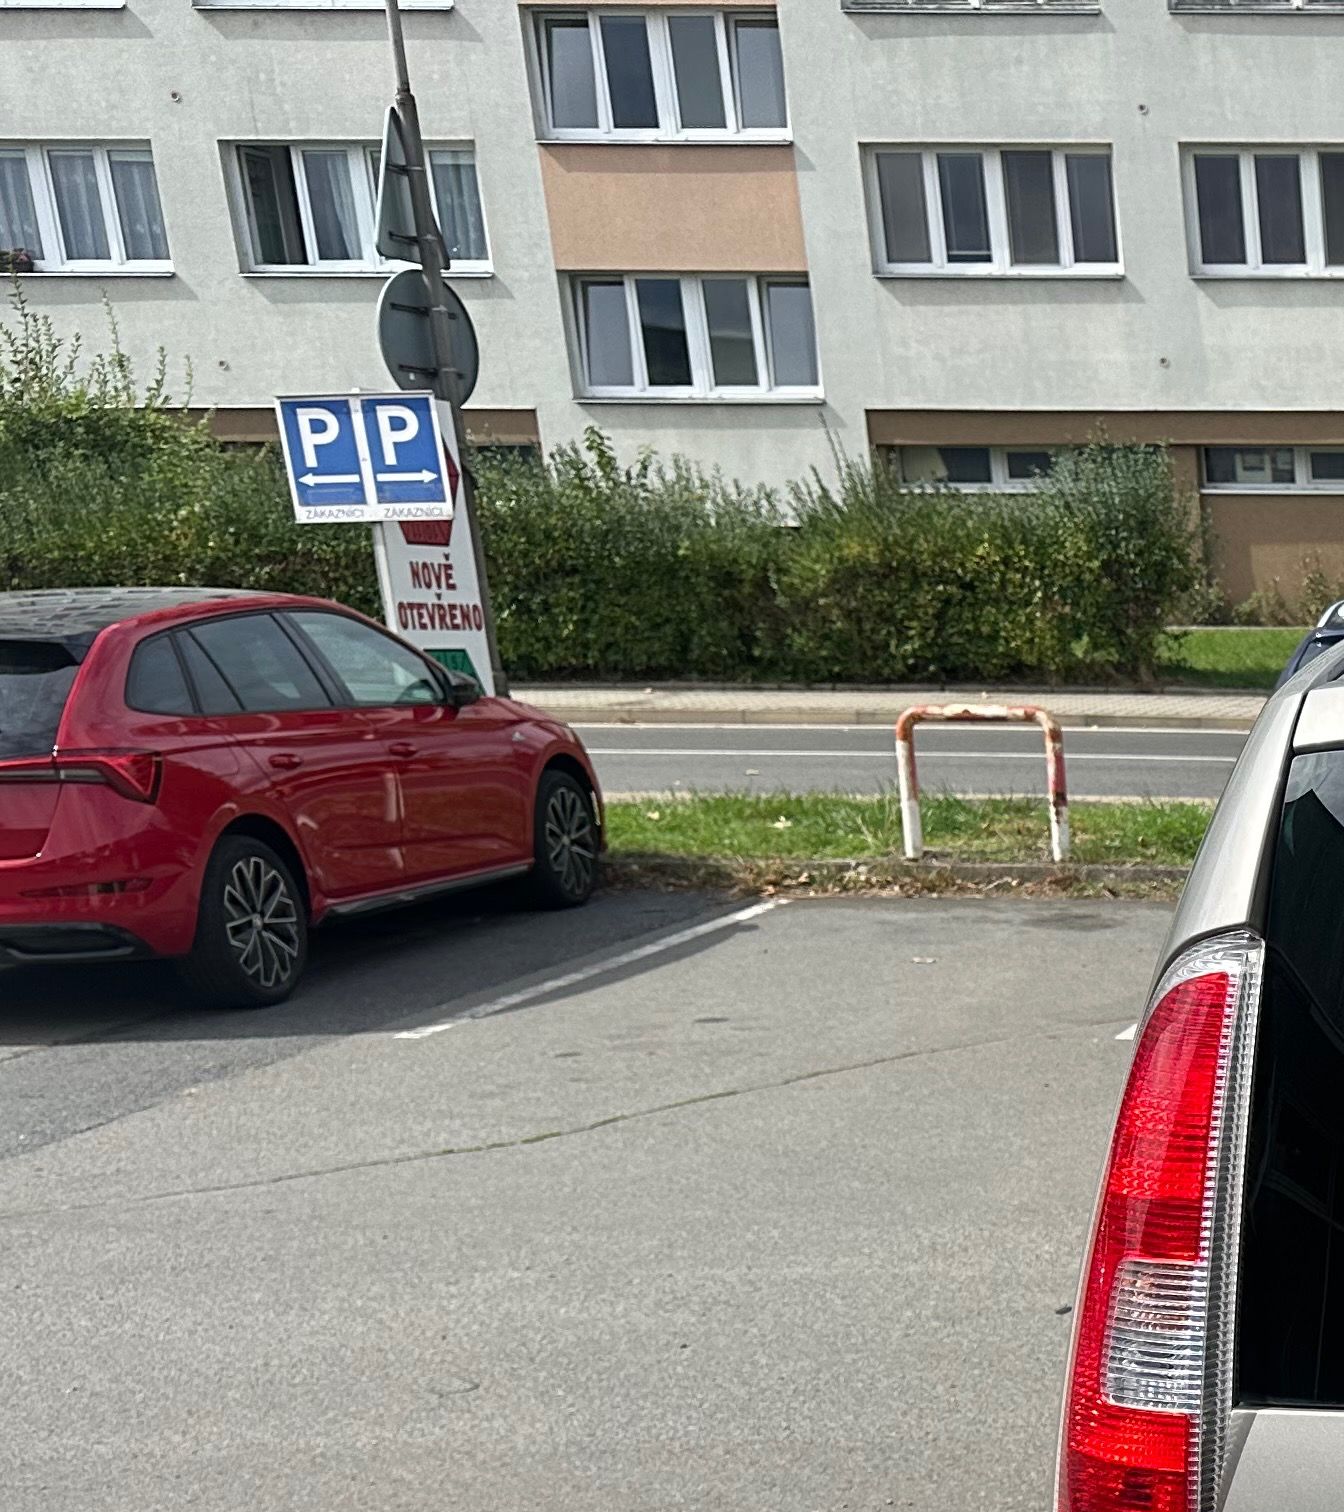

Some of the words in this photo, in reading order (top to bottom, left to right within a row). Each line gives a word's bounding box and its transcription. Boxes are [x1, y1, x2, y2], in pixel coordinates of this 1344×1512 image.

[296, 407, 340, 468] P
[375, 405, 419, 466] P
[409, 552, 457, 592] NOVĚ
[397, 592, 484, 632] OTEVŘENO
